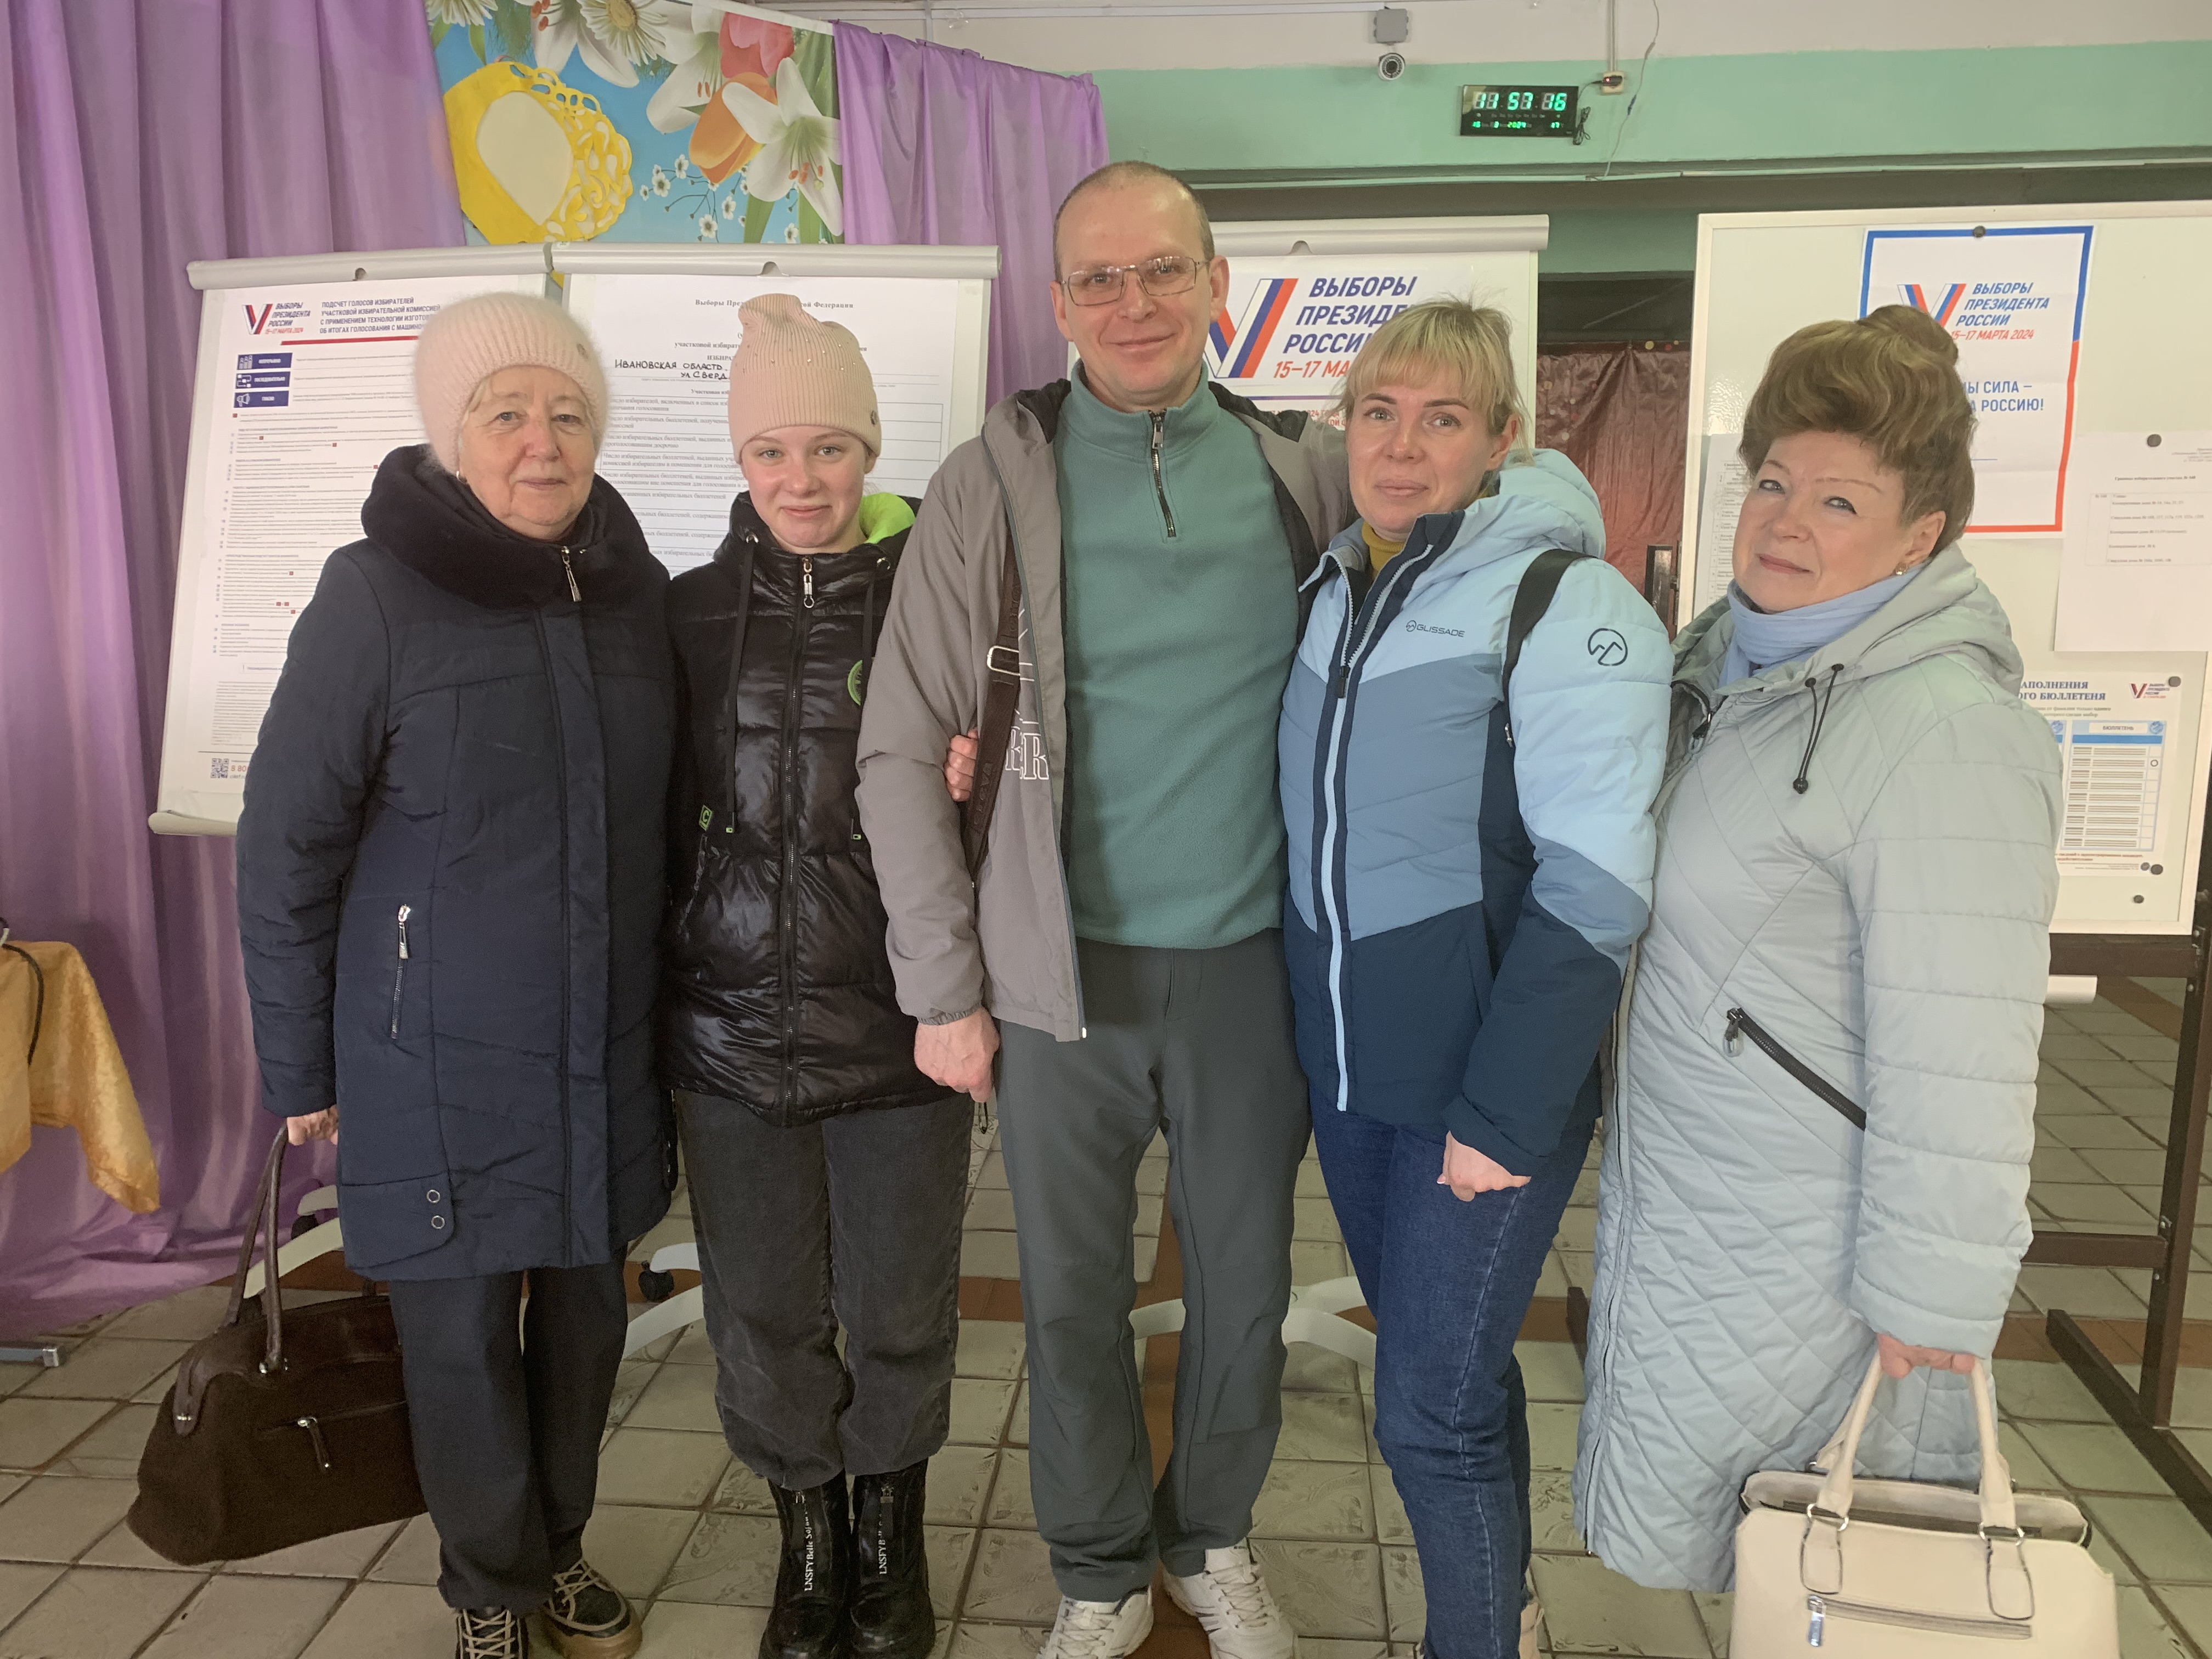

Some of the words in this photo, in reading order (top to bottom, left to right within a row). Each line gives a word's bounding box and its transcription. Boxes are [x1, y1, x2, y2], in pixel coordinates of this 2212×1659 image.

[1508, 92, 1534, 110] 57
[1546, 92, 1567, 111] 16
[1308, 276, 1418, 298] ВЫБОРЫ
[1972, 282, 2034, 295] ВЫБОРЫ
[375, 296, 414, 306] ИЗБИРАТЕЛЕЙ
[1964, 297, 2050, 312] ПРЕЗИДЕНТА
[321, 308, 357, 317] УЧАСТКОВОЙ
[358, 306, 405, 314] ИЗБИРАТЕЛЬНОЙ
[1955, 314, 2011, 327] РОССИИ
[1976, 330, 2010, 340] МАРТА
[2010, 329, 2034, 340] 2024
[713, 341, 739, 349] избират
[1984, 381, 2019, 394] СИЛА
[1981, 398, 2044, 411] РОССИЮ!
[1417, 624, 1465, 637] GLISSADE
[2021, 681, 2089, 690] АПОЛНЕНИЯ
[2040, 692, 2106, 701] БЮЛЛЕТЕНЯ
